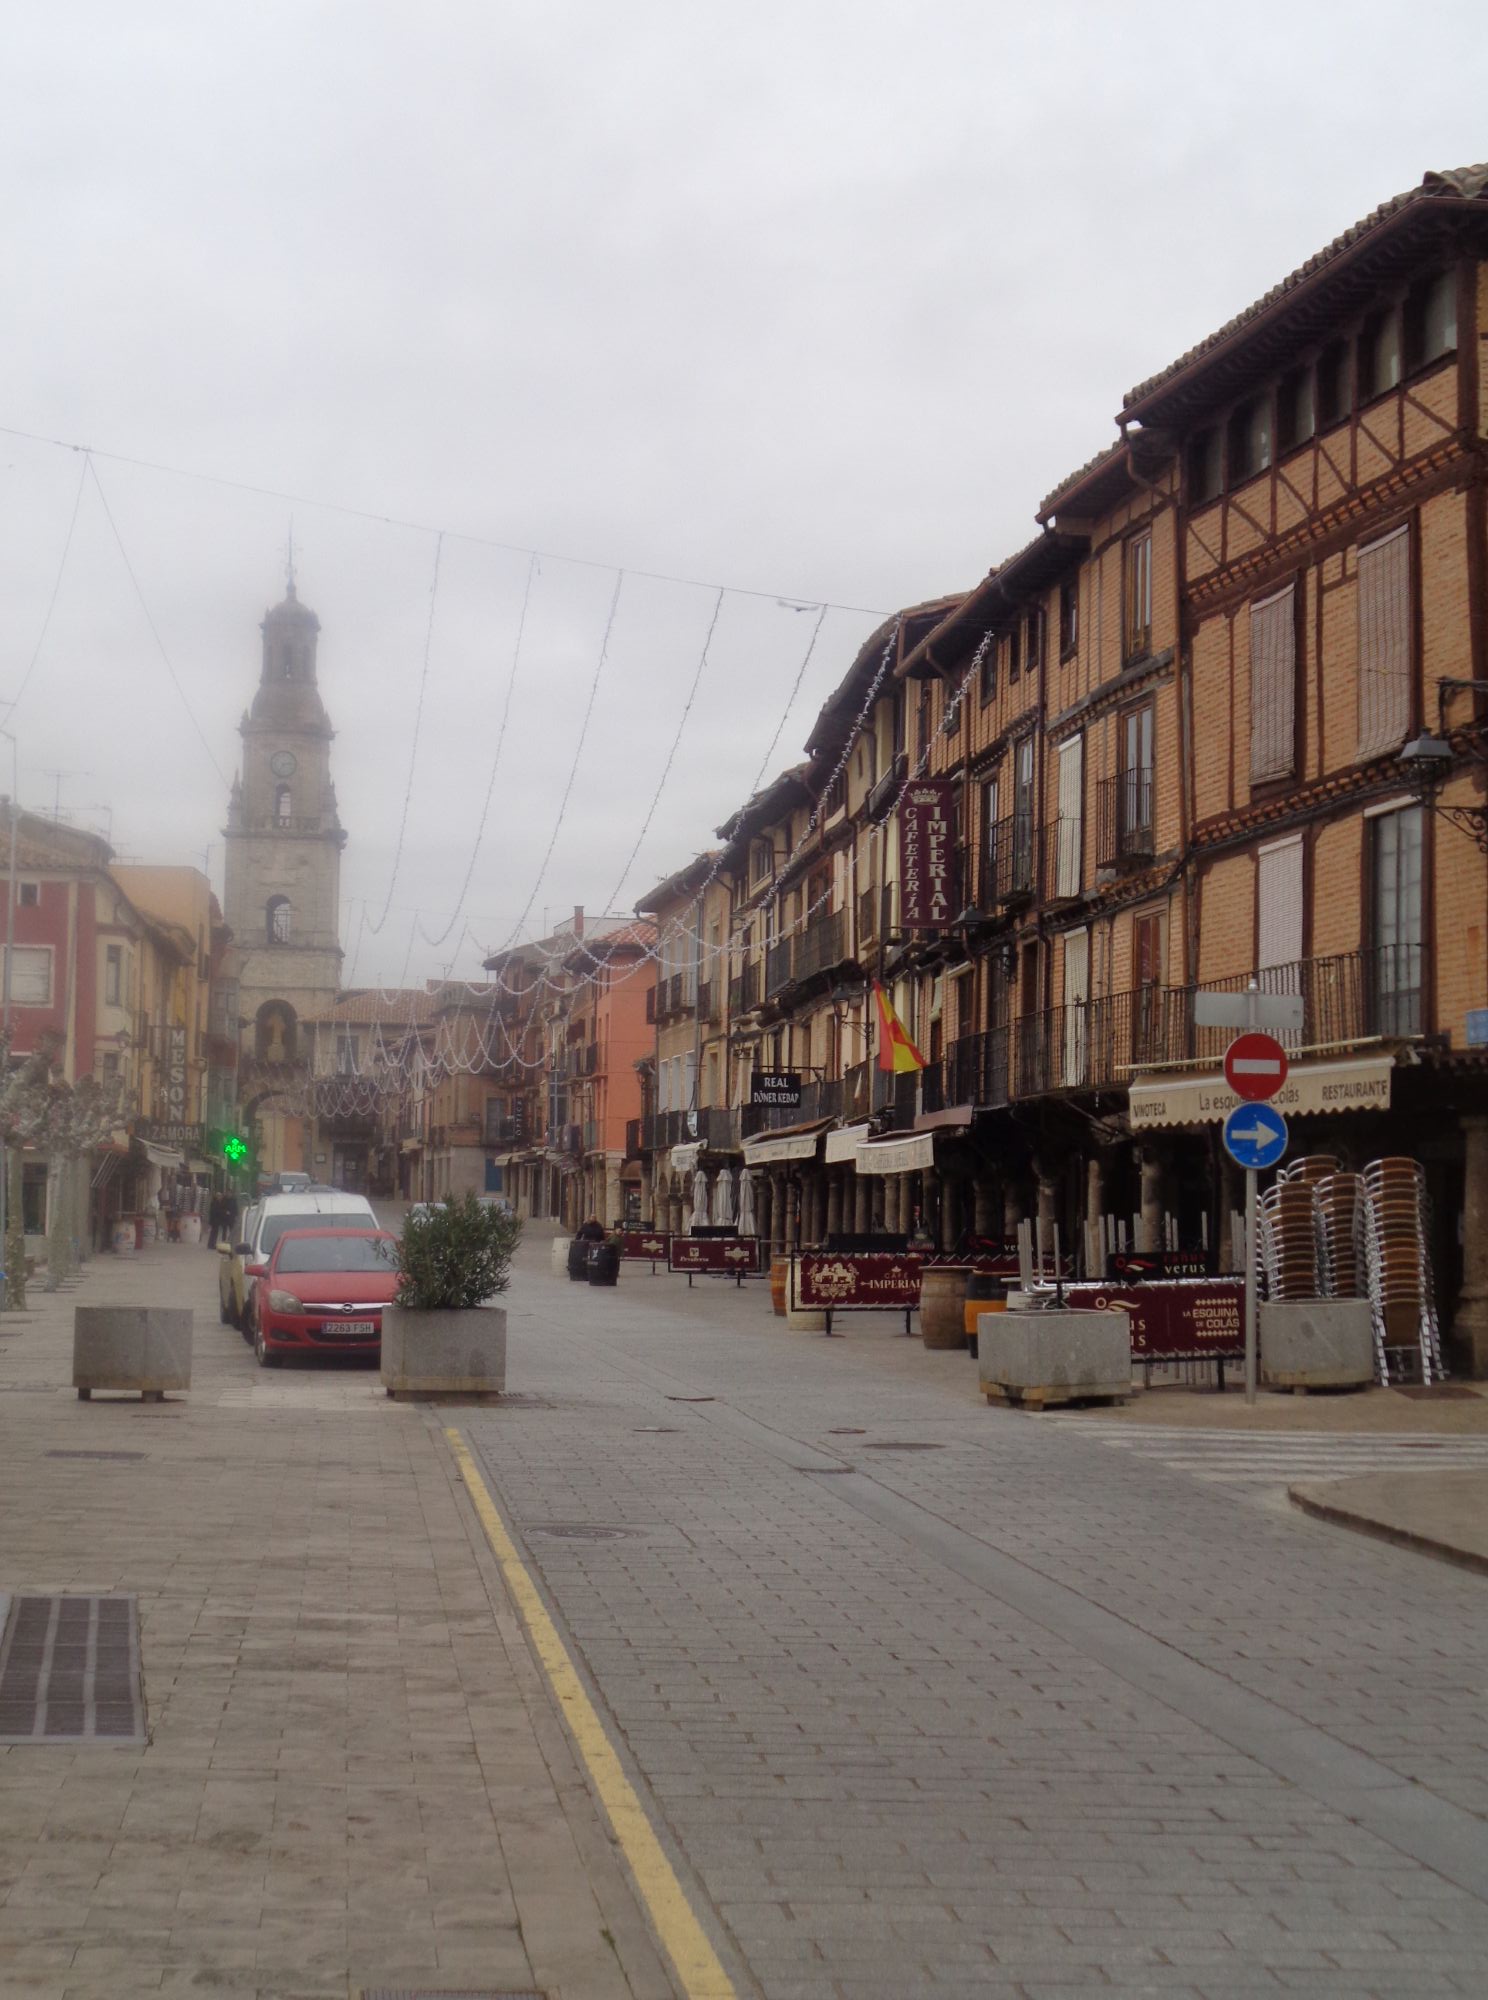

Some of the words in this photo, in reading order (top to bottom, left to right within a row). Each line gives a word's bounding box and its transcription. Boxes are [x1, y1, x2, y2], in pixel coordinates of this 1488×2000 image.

[927, 806, 948, 920] IMPERIAL
[169, 1030, 185, 1121] MESON
[764, 1077, 789, 1088] REAL
[1322, 1080, 1388, 1102] RESTAURANTE
[1199, 1092, 1210, 1111] La
[1133, 1102, 1167, 1117] VINOTECA
[152, 1125, 200, 1141] ZAMORA
[1164, 1264, 1206, 1274] verus
[1182, 1310, 1191, 1318] LA
[1192, 1307, 1239, 1318] ESQUINA
[354, 1324, 371, 1332] FSH
